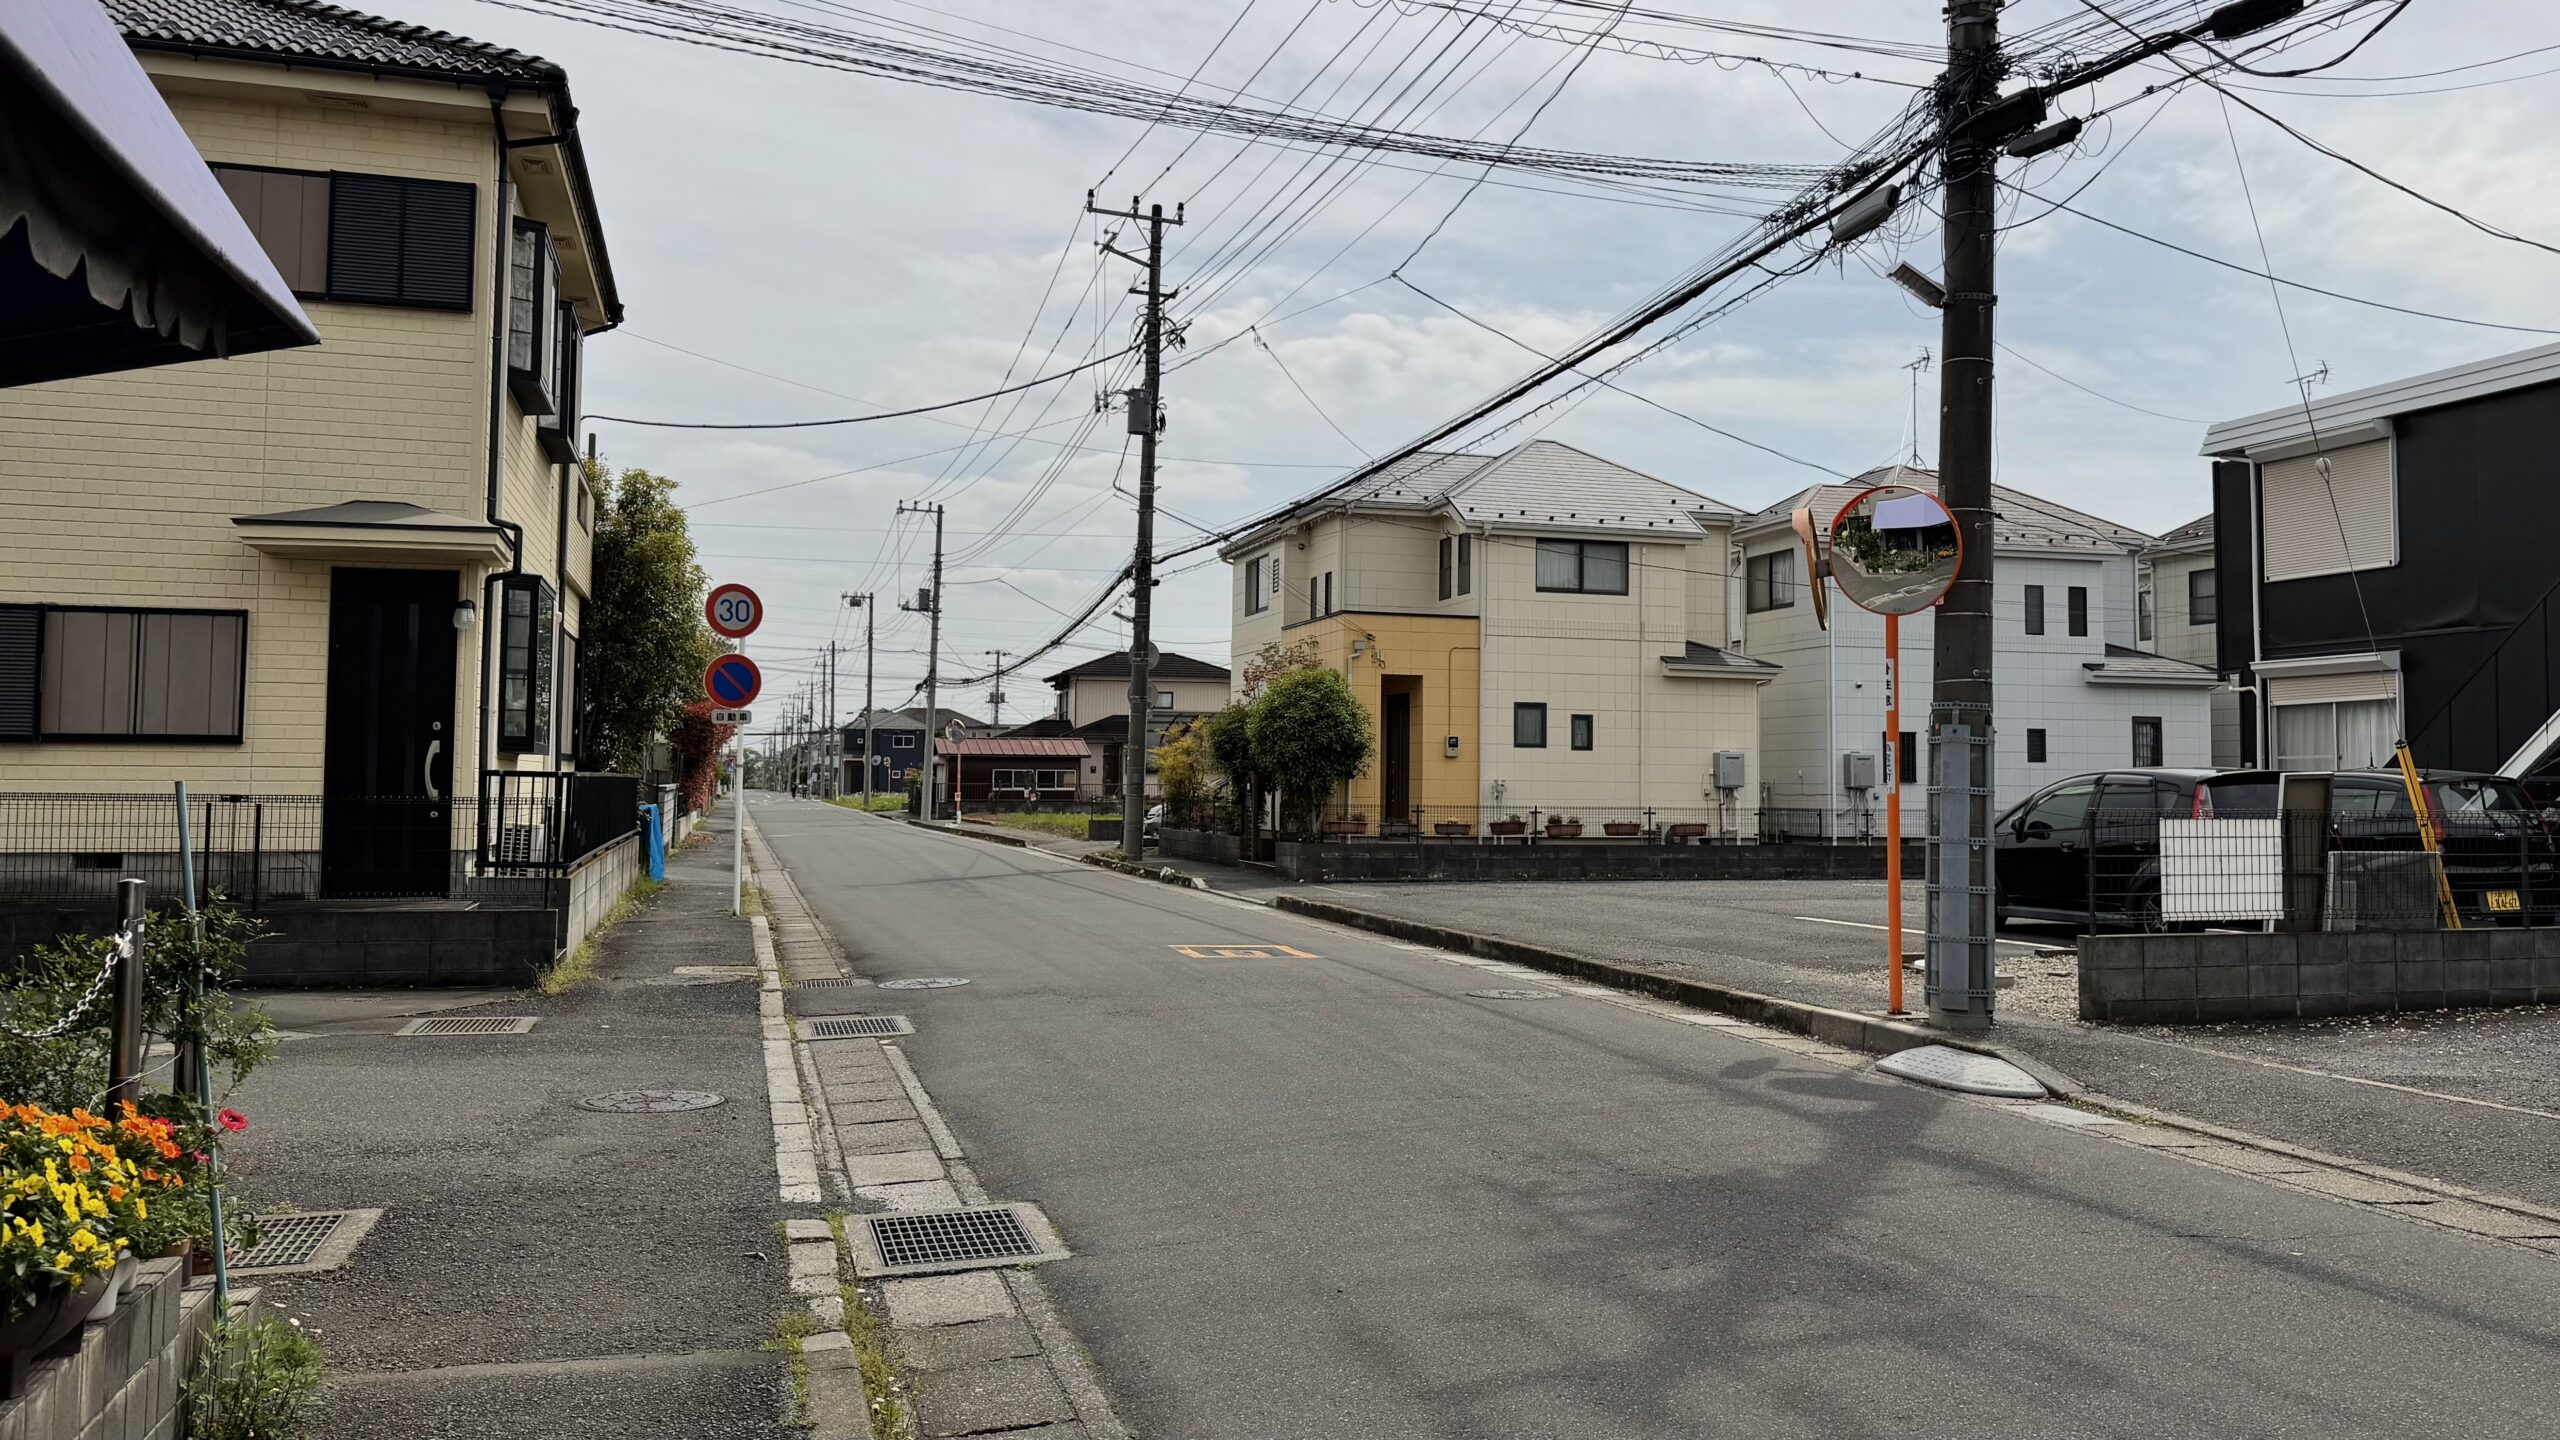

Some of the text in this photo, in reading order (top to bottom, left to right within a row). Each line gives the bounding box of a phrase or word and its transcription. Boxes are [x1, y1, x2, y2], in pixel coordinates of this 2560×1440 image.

[719, 599, 750, 622] 30
[716, 712, 748, 722] 自動車
